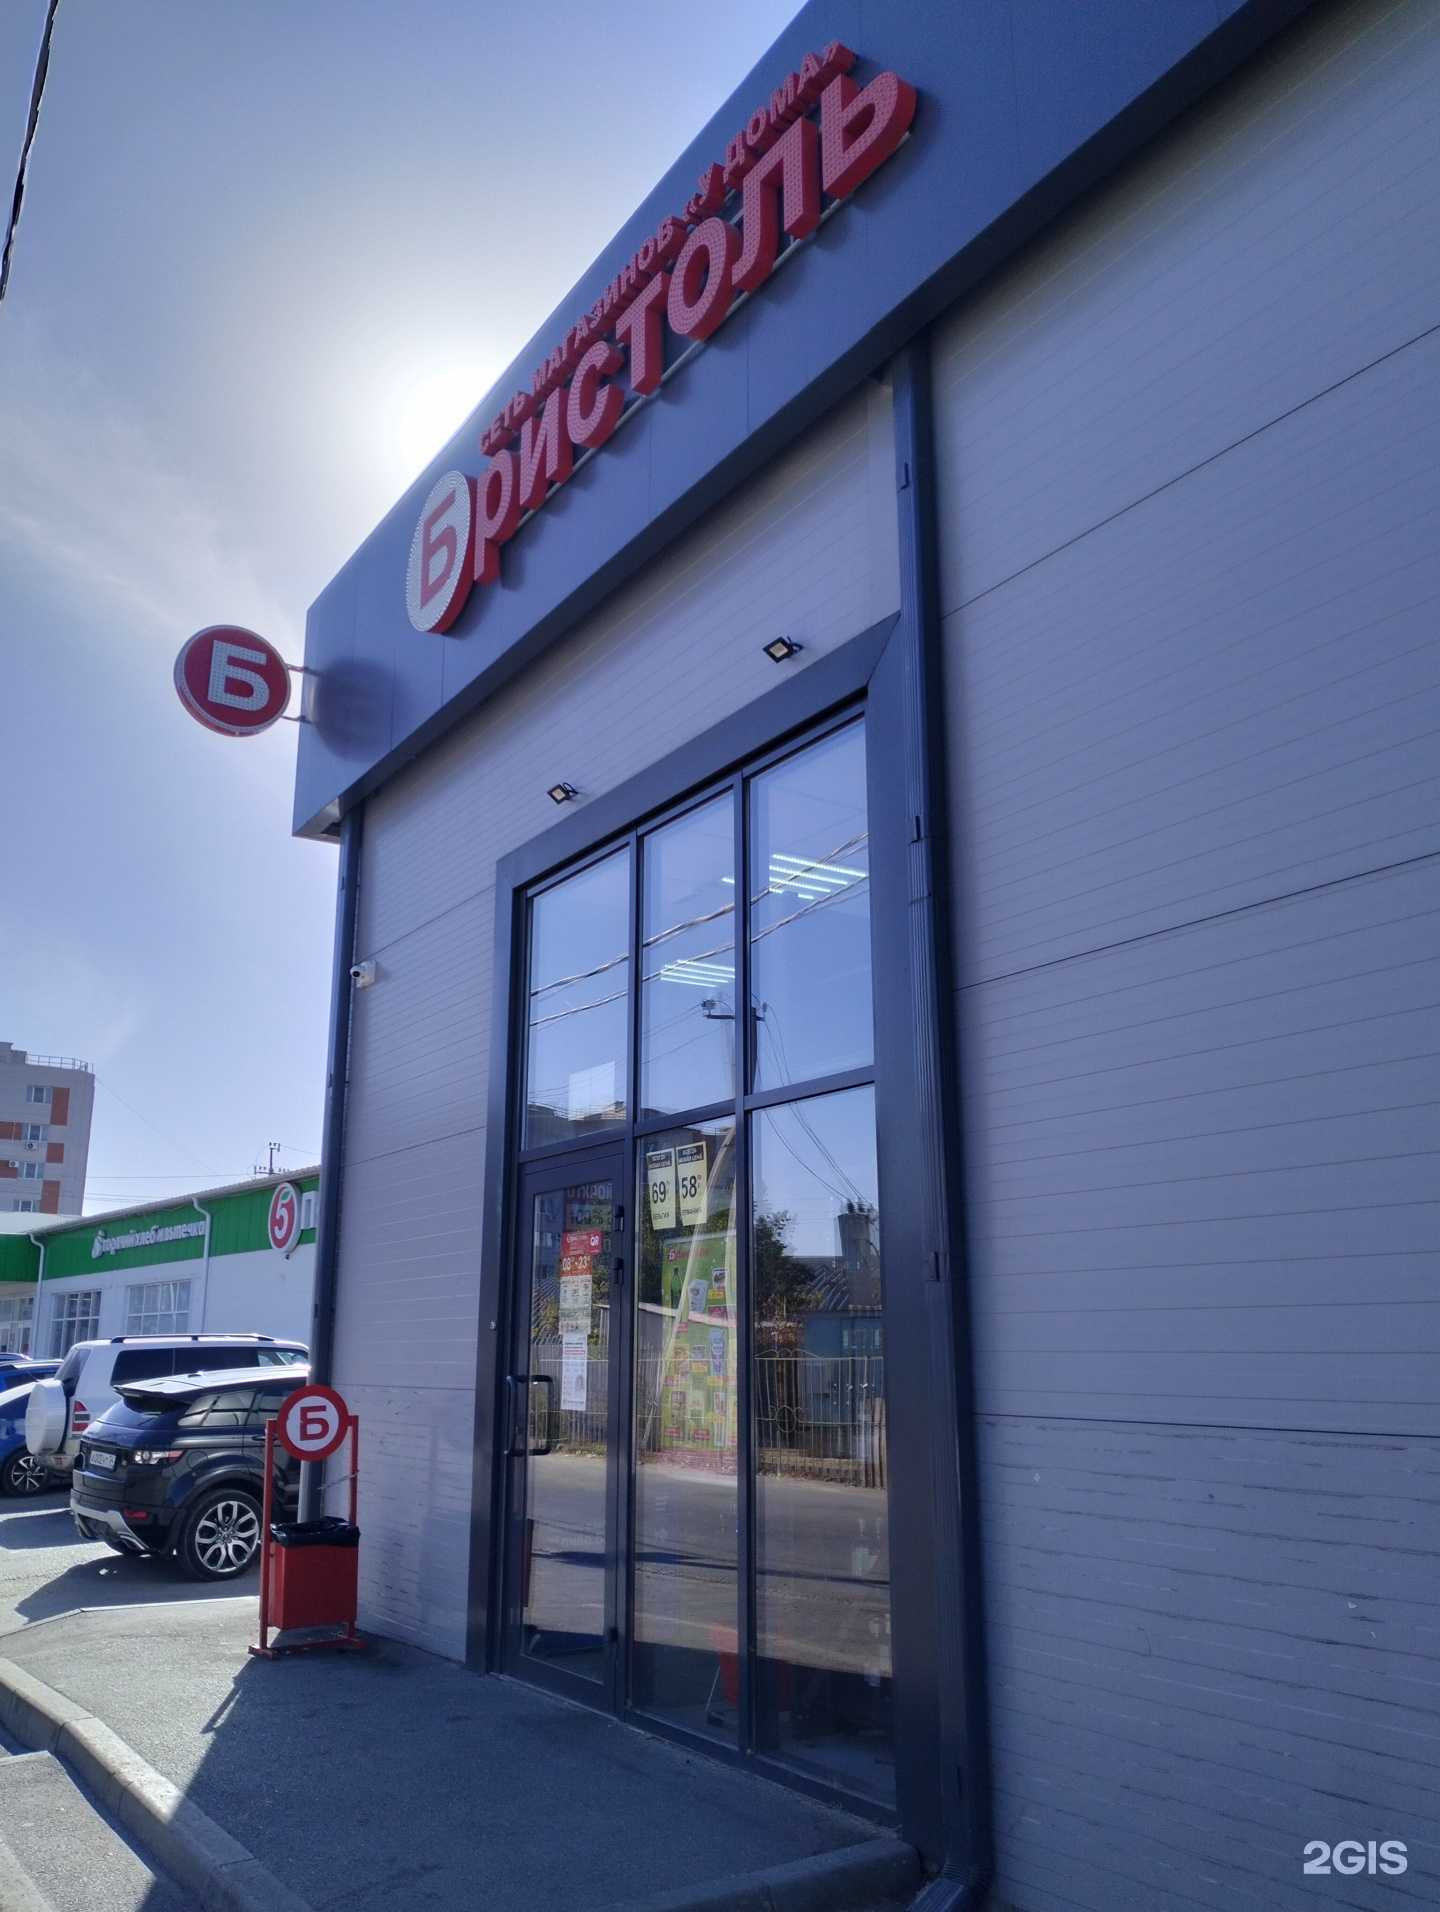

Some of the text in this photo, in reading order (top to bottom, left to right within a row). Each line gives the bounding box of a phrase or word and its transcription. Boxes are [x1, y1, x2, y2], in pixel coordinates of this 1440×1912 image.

[532, 215, 687, 398] МАГАЗИНОВ
[207, 639, 270, 712] Б
[299, 1405, 330, 1442] Б
